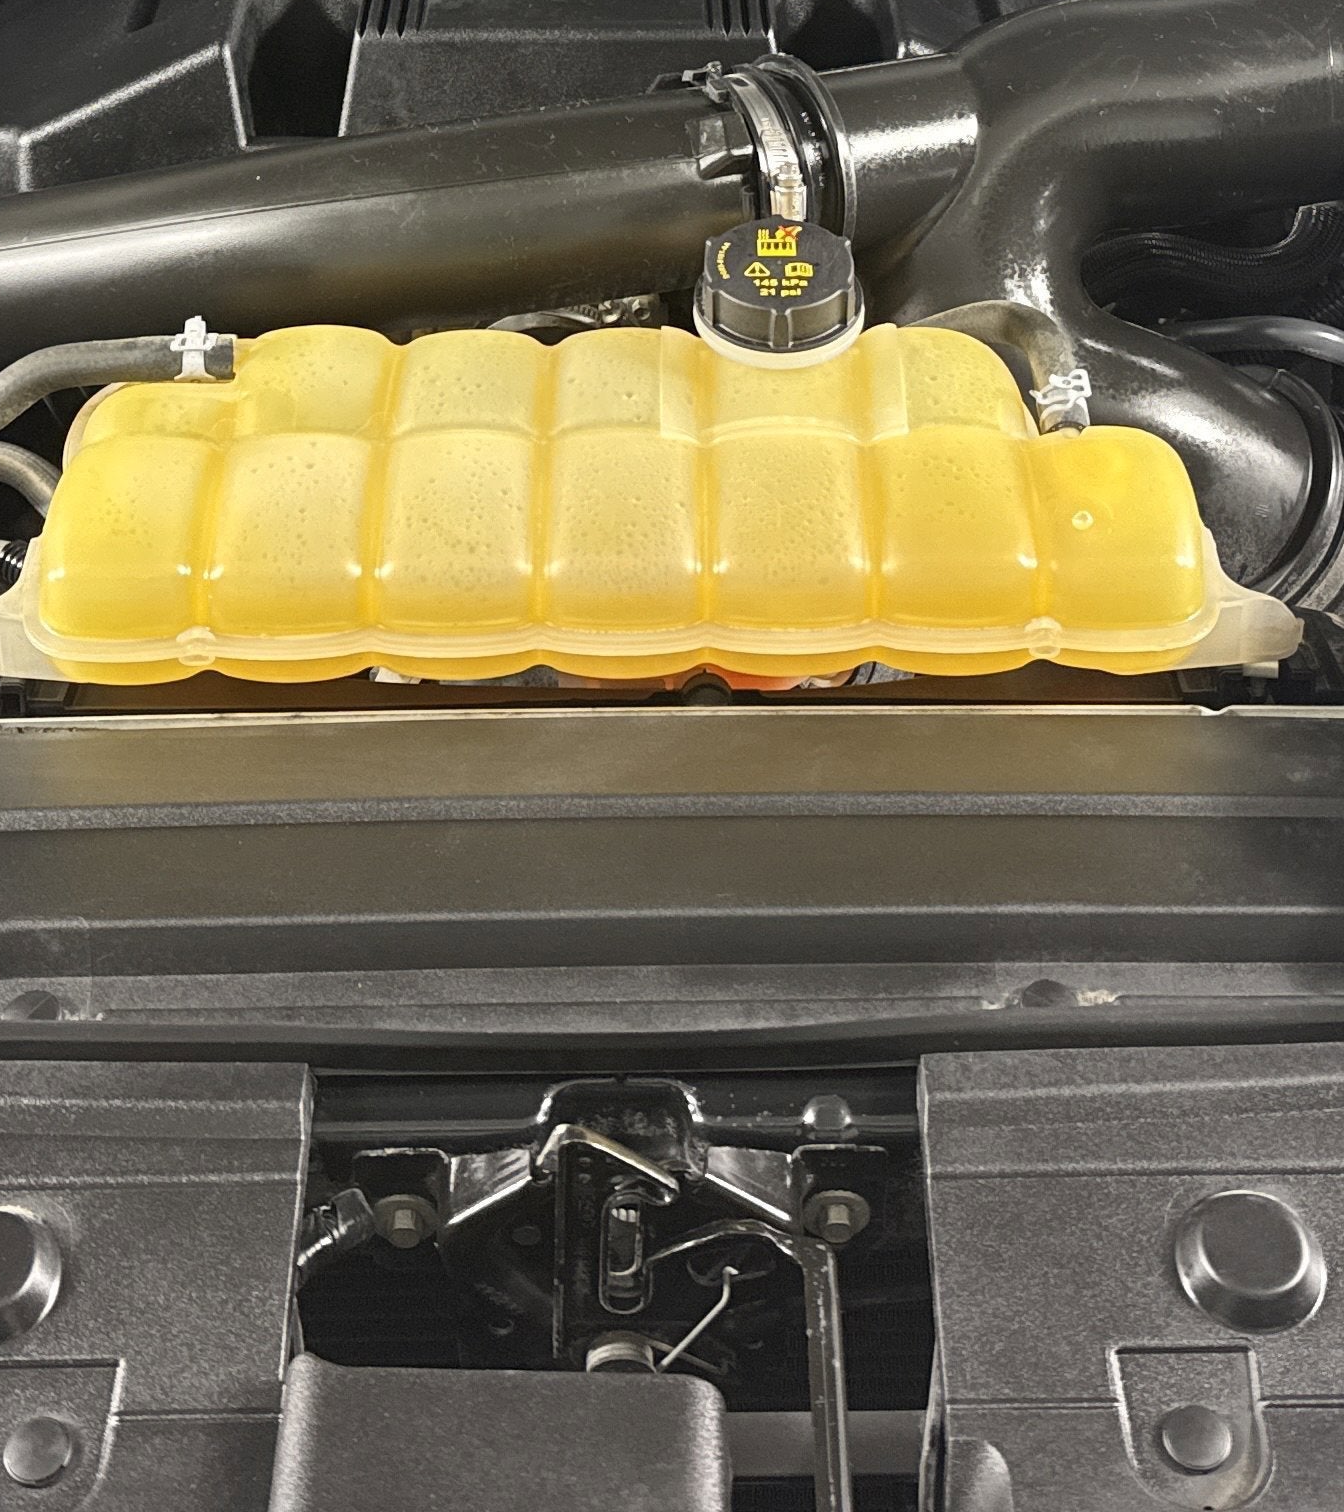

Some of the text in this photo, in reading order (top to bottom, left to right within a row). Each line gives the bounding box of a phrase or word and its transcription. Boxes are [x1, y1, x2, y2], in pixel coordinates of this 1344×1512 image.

[753, 278, 808, 287] 145 kPa
[759, 288, 802, 297] 21 psi
